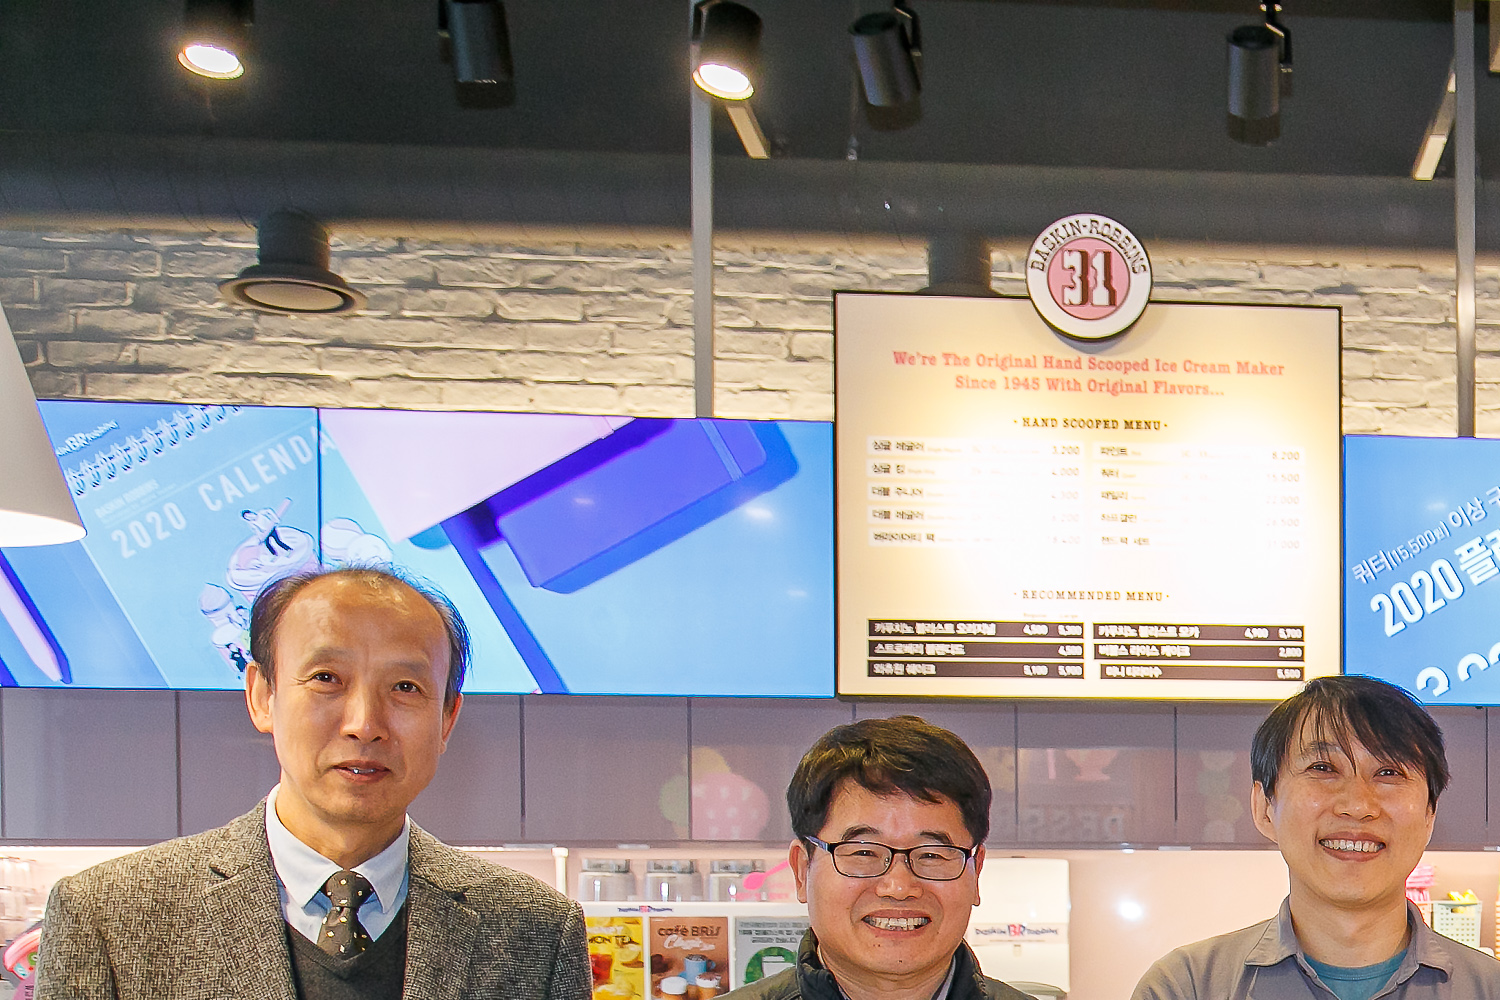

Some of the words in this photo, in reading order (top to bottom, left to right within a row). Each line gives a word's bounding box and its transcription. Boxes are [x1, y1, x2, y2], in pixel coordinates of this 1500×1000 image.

[1062, 249, 1117, 306] 31
[891, 350, 937, 367] We're
[941, 352, 970, 367] The
[975, 353, 1037, 372] Original
[1042, 354, 1083, 371] Hand
[1087, 355, 1150, 375] Scooped
[1154, 357, 1178, 373] Ice
[1182, 359, 1231, 374] Cream
[1236, 361, 1285, 376] Maker
[955, 374, 997, 390] Since
[1003, 376, 1041, 391] 1945
[1045, 377, 1083, 393] With
[1086, 377, 1149, 397] Original
[1152, 379, 1224, 396] Flavors...
[1022, 417, 1058, 428] HAND
[1062, 418, 1119, 430] SCOOPED
[1123, 419, 1161, 431] MENU
[1449, 497, 1487, 530] 이상
[111, 501, 188, 560] 2020
[1022, 590, 1121, 601] RECOMMENDED
[1126, 591, 1163, 602] MENU
[1370, 558, 1465, 638] 2020
